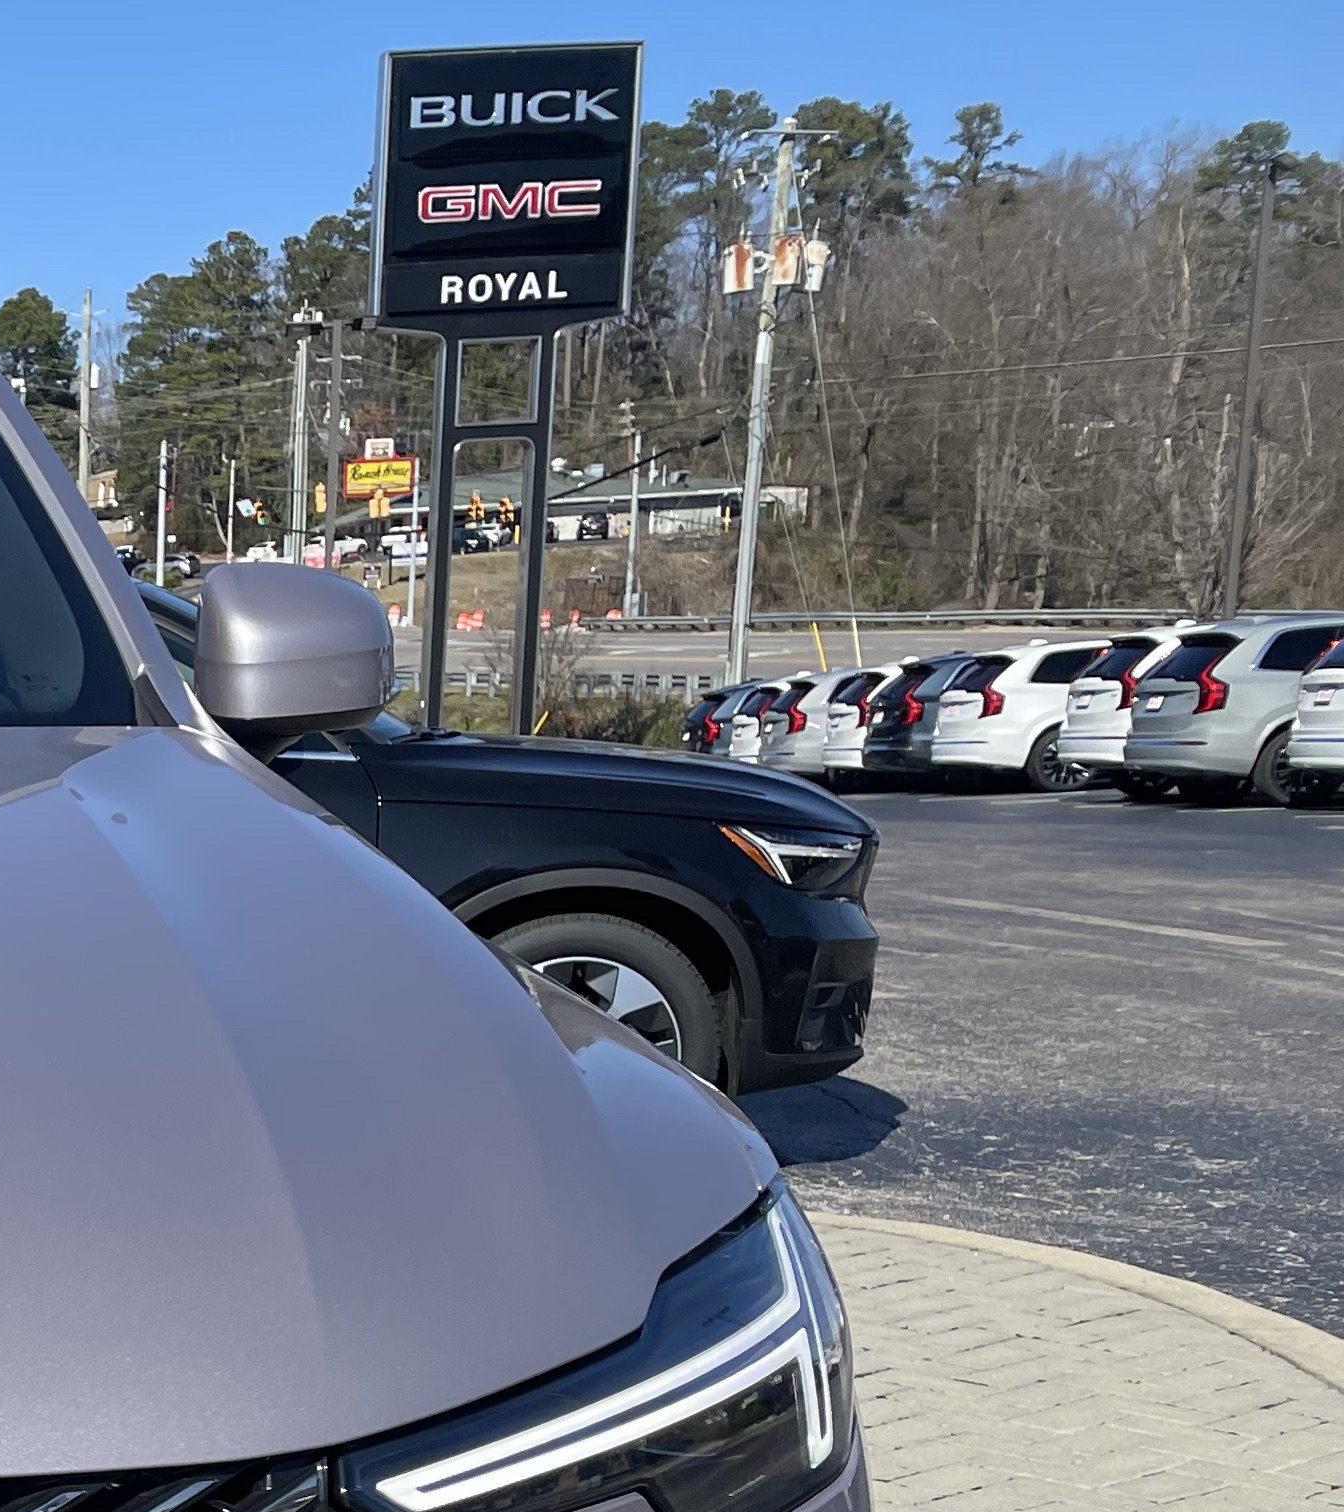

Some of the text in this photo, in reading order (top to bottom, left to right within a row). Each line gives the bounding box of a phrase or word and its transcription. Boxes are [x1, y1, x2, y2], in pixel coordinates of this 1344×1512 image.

[409, 88, 620, 129] BUICK
[417, 178, 603, 224] GMC
[440, 270, 568, 304] ROYAL
